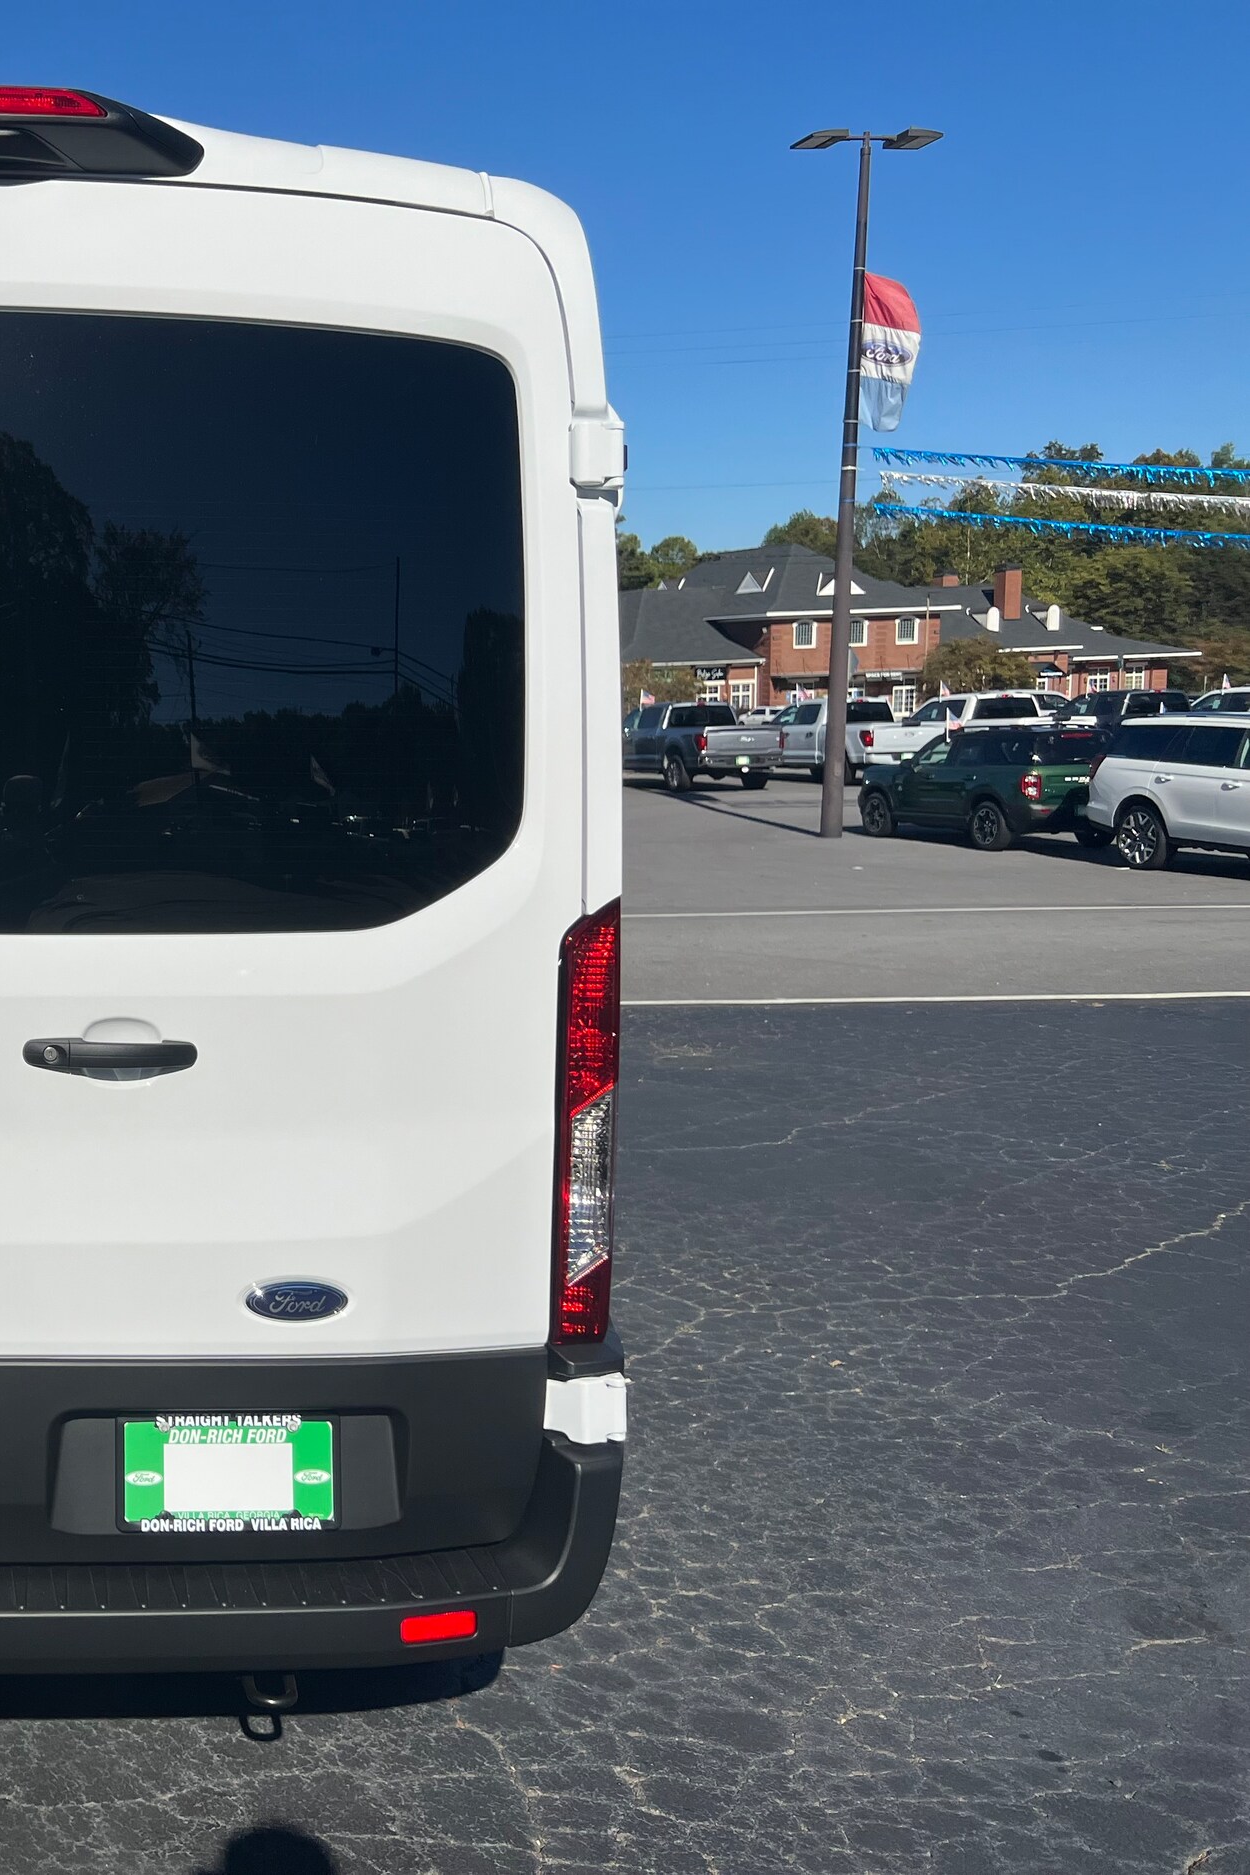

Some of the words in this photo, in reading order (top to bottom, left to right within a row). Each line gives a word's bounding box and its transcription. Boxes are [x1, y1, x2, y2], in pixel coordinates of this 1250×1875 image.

[865, 344, 901, 364] Ford
[269, 1290, 326, 1313] Ford
[168, 1428, 243, 1444] DON-RICH
[246, 1428, 288, 1444] FORD
[132, 1473, 155, 1483] Ford
[301, 1472, 323, 1482] Ford
[140, 1518, 206, 1532] DON-RICH
[208, 1518, 244, 1532] FORD
[251, 1518, 288, 1531] VILLA
[290, 1517, 322, 1531] RICA
